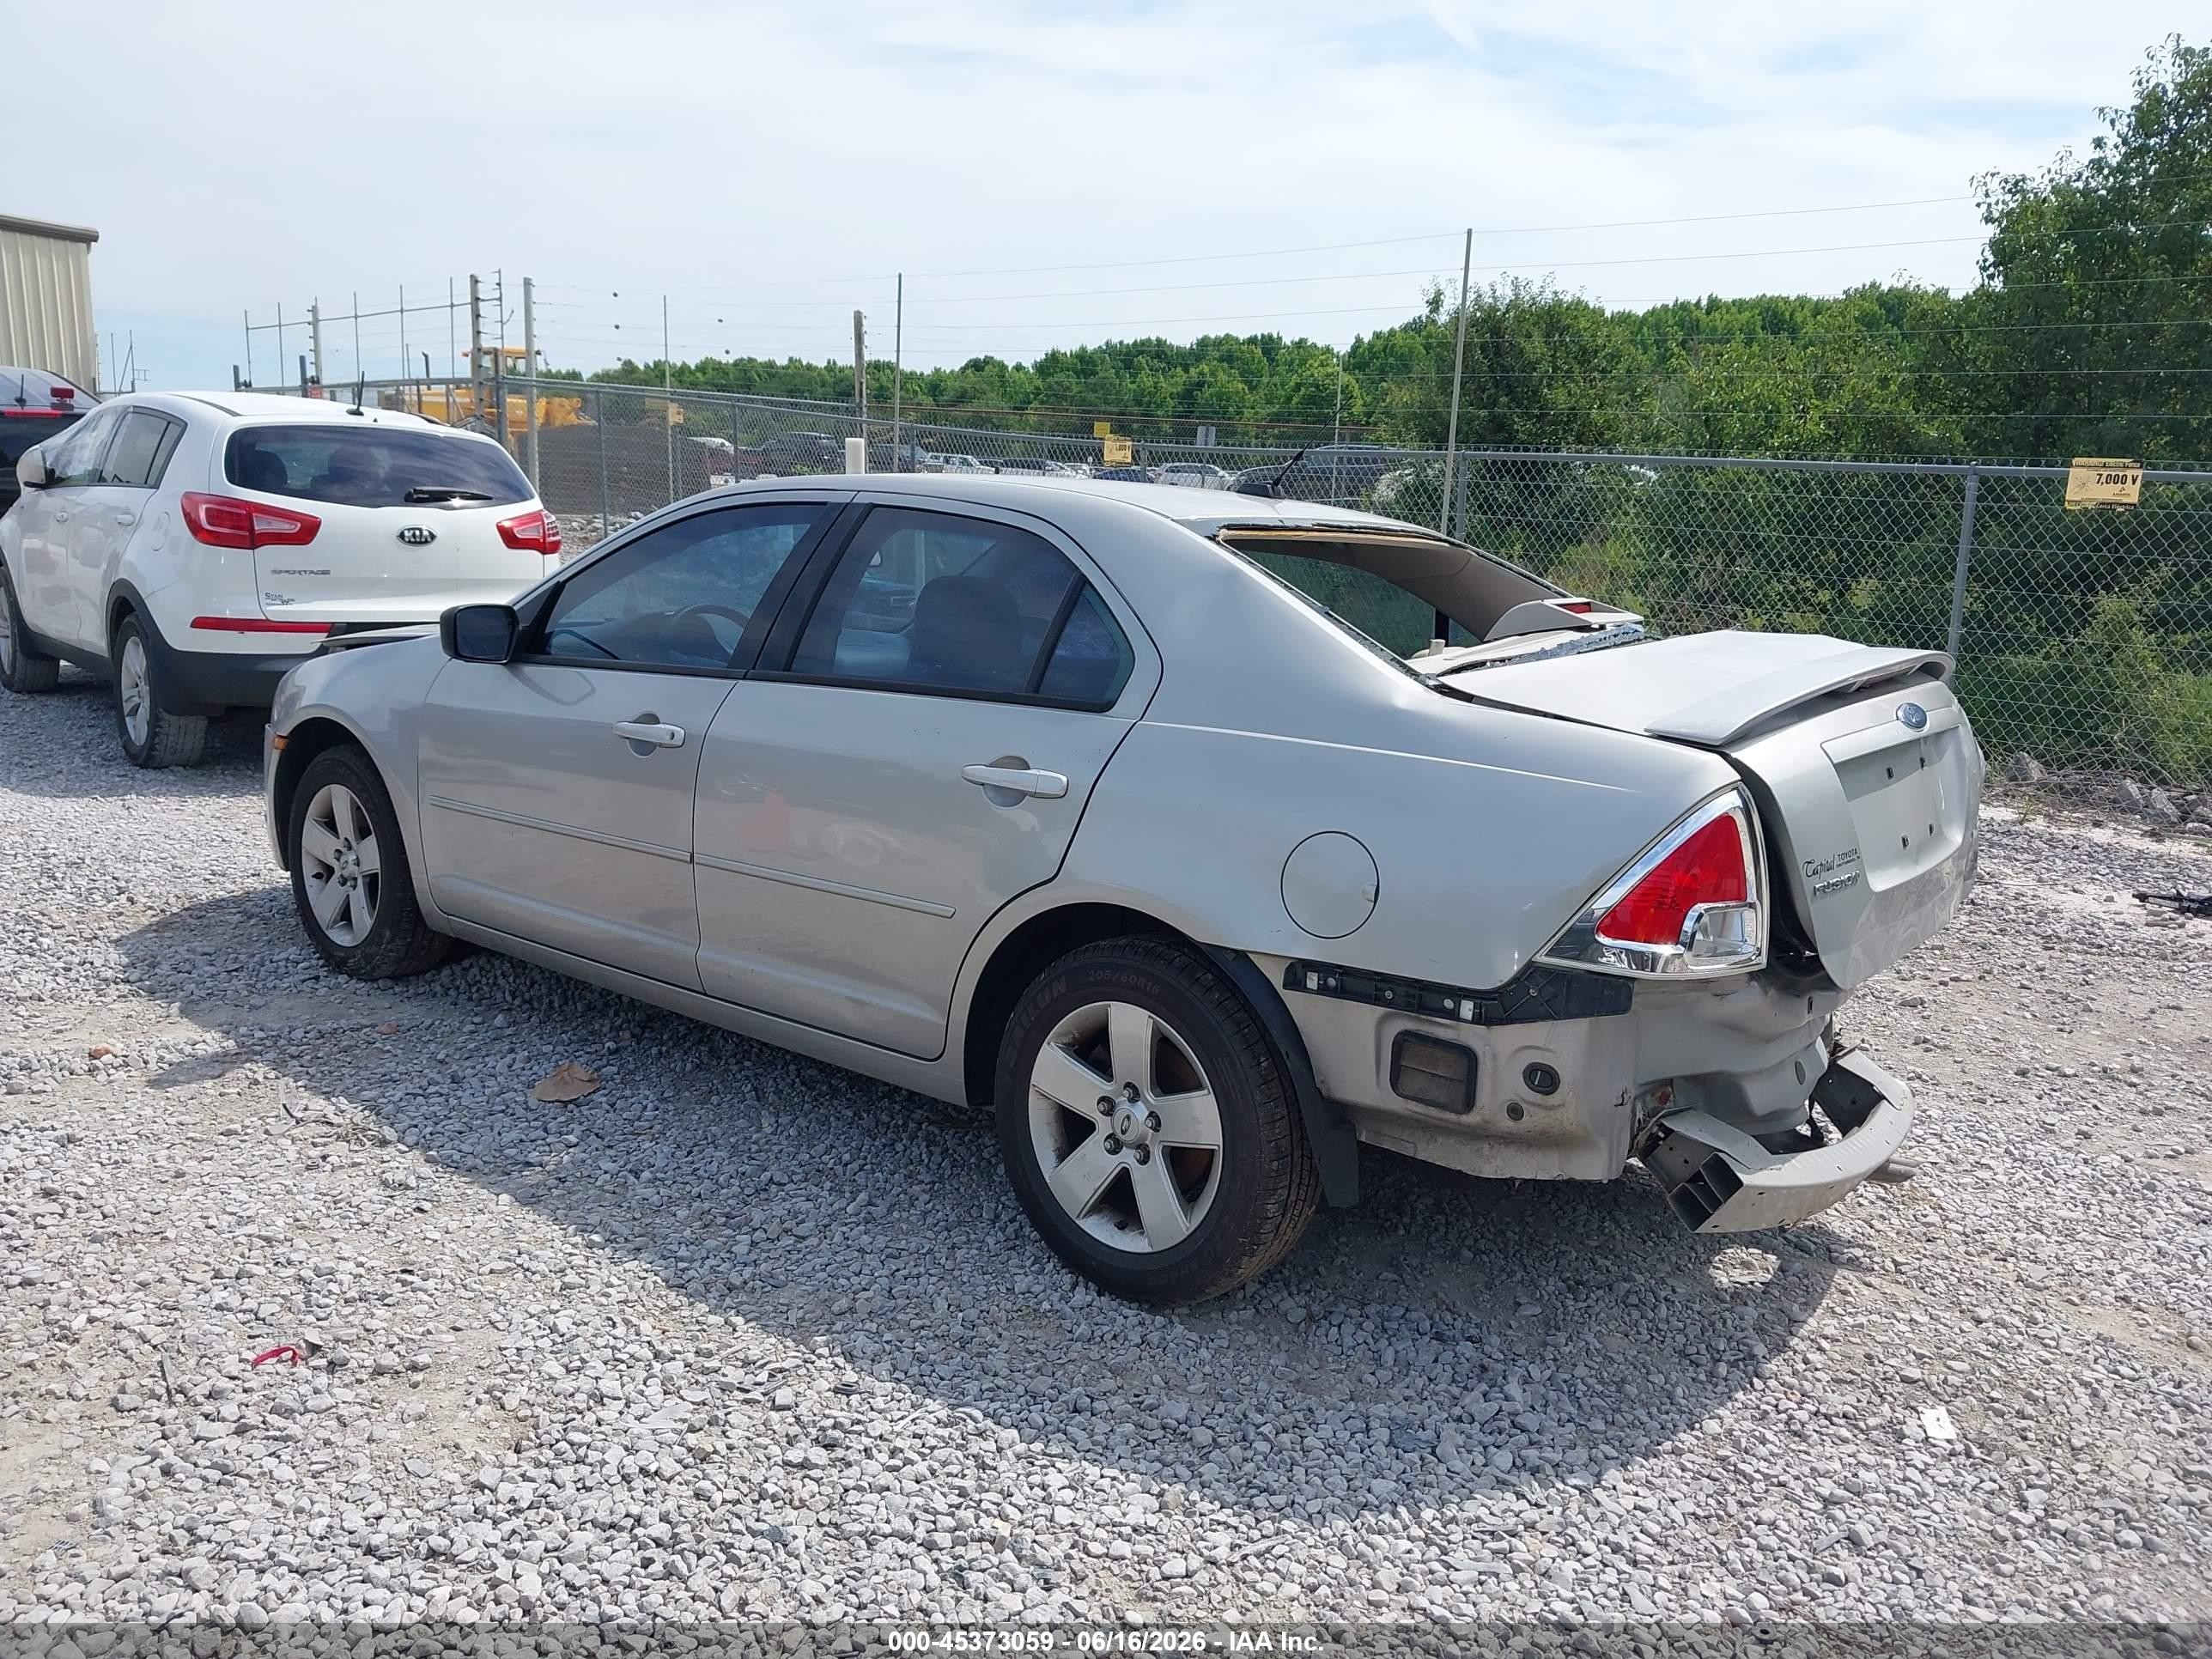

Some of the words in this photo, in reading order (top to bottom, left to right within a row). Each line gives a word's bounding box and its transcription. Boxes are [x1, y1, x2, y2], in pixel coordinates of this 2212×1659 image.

[2096, 473, 2128, 486] 7,000
[2131, 474, 2139, 485] V
[404, 529, 432, 542] KIA
[1802, 854, 1835, 879] Capital
[1837, 848, 1858, 862] TOYOTA
[1813, 870, 1861, 896] FUSION
[1087, 969, 1161, 996] 205/60R16
